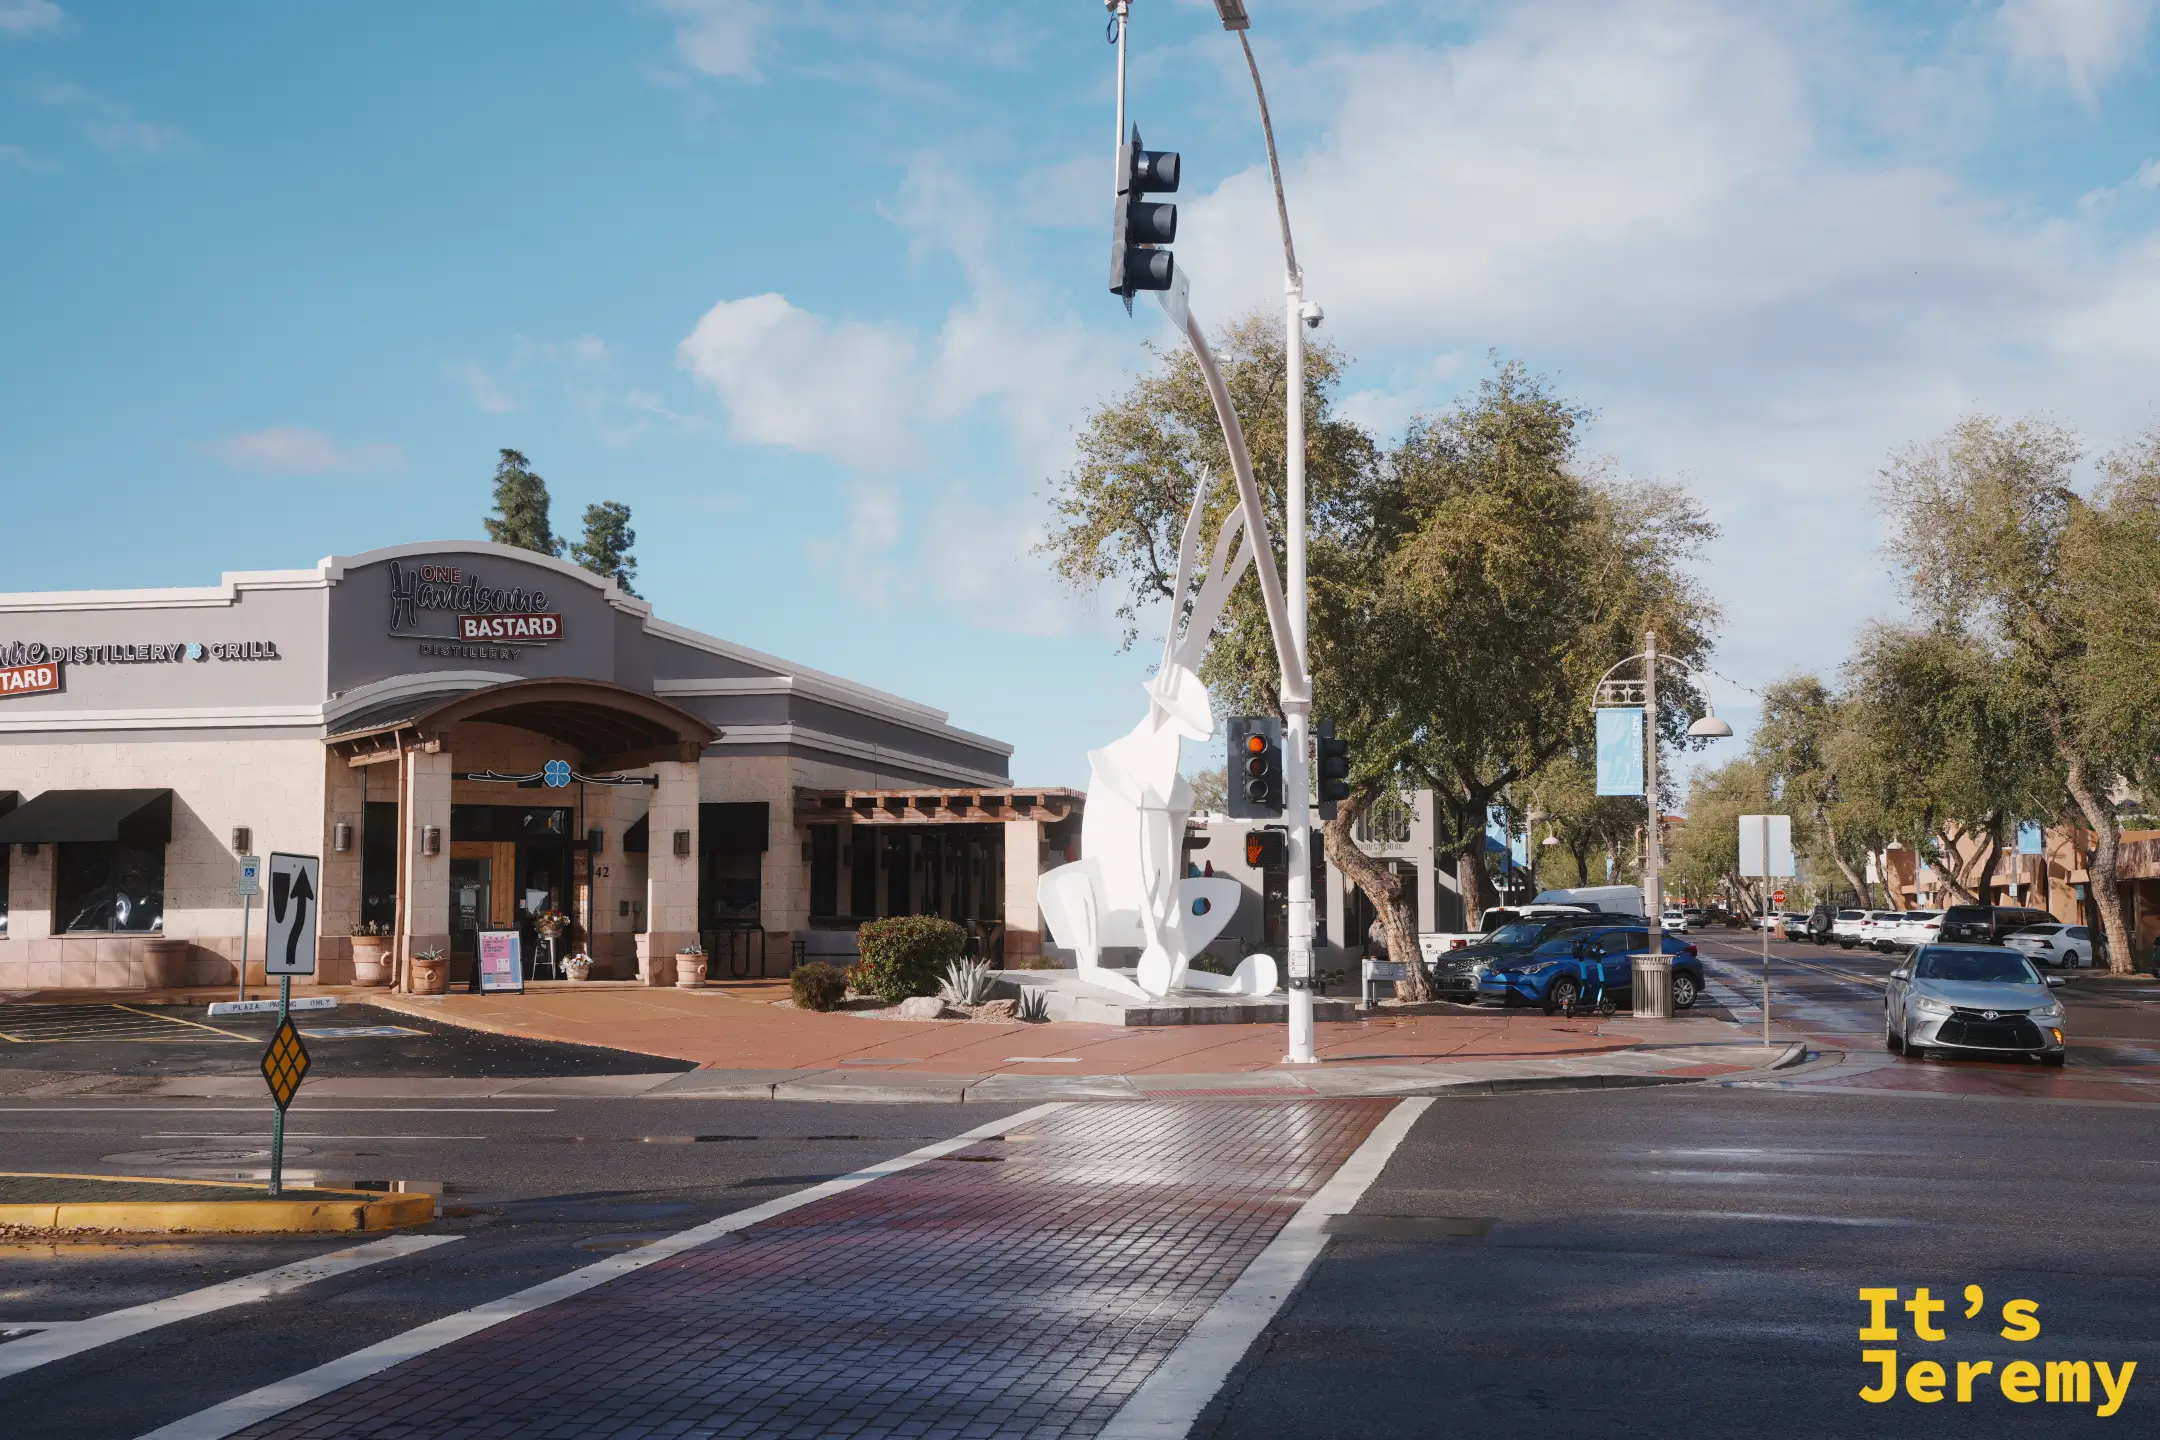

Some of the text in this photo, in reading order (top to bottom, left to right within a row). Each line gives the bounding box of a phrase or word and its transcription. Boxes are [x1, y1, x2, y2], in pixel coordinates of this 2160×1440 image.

[420, 564, 462, 584] ONE
[389, 560, 550, 630] Handsome
[464, 617, 557, 637] BASTARD
[51, 641, 275, 661] DISTILLERY GRILL
[420, 643, 521, 660] DISTILLERY
[0, 668, 52, 690] TARD
[310, 999, 330, 1007] ONLY
